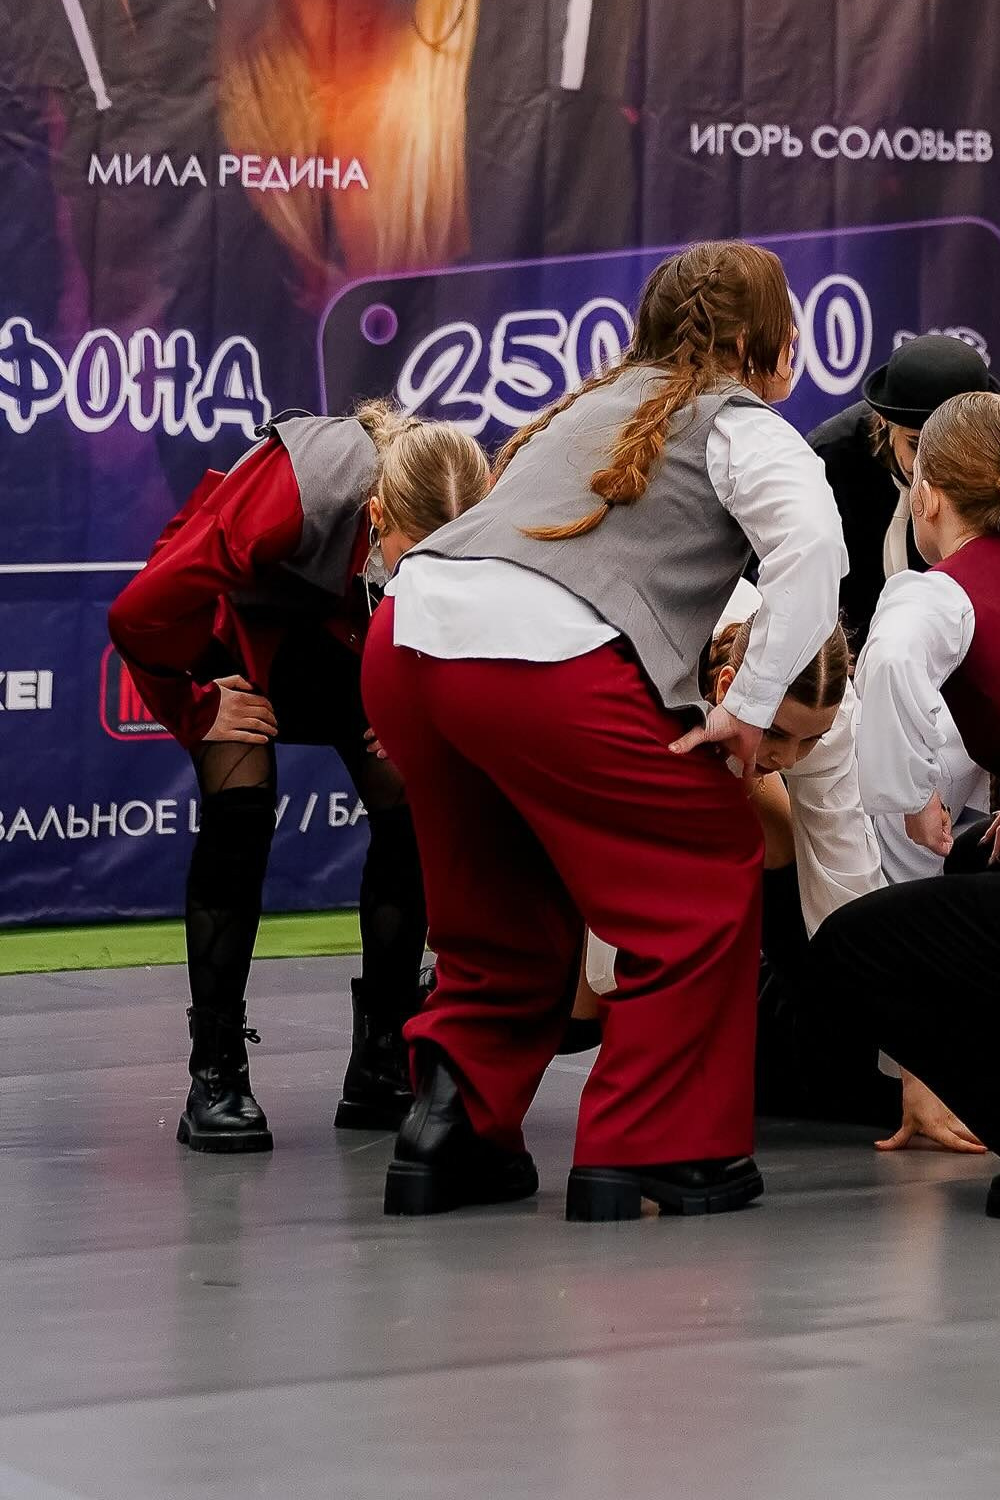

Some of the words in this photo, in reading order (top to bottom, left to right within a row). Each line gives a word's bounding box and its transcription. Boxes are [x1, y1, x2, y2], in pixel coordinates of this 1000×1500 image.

[689, 122, 803, 158] ИГОРЬ
[810, 124, 994, 162] СОЛОВЬЕВ
[88, 153, 208, 187] МИЛА
[218, 154, 369, 192] РЕДИНА
[0, 316, 272, 442] ФОНД
